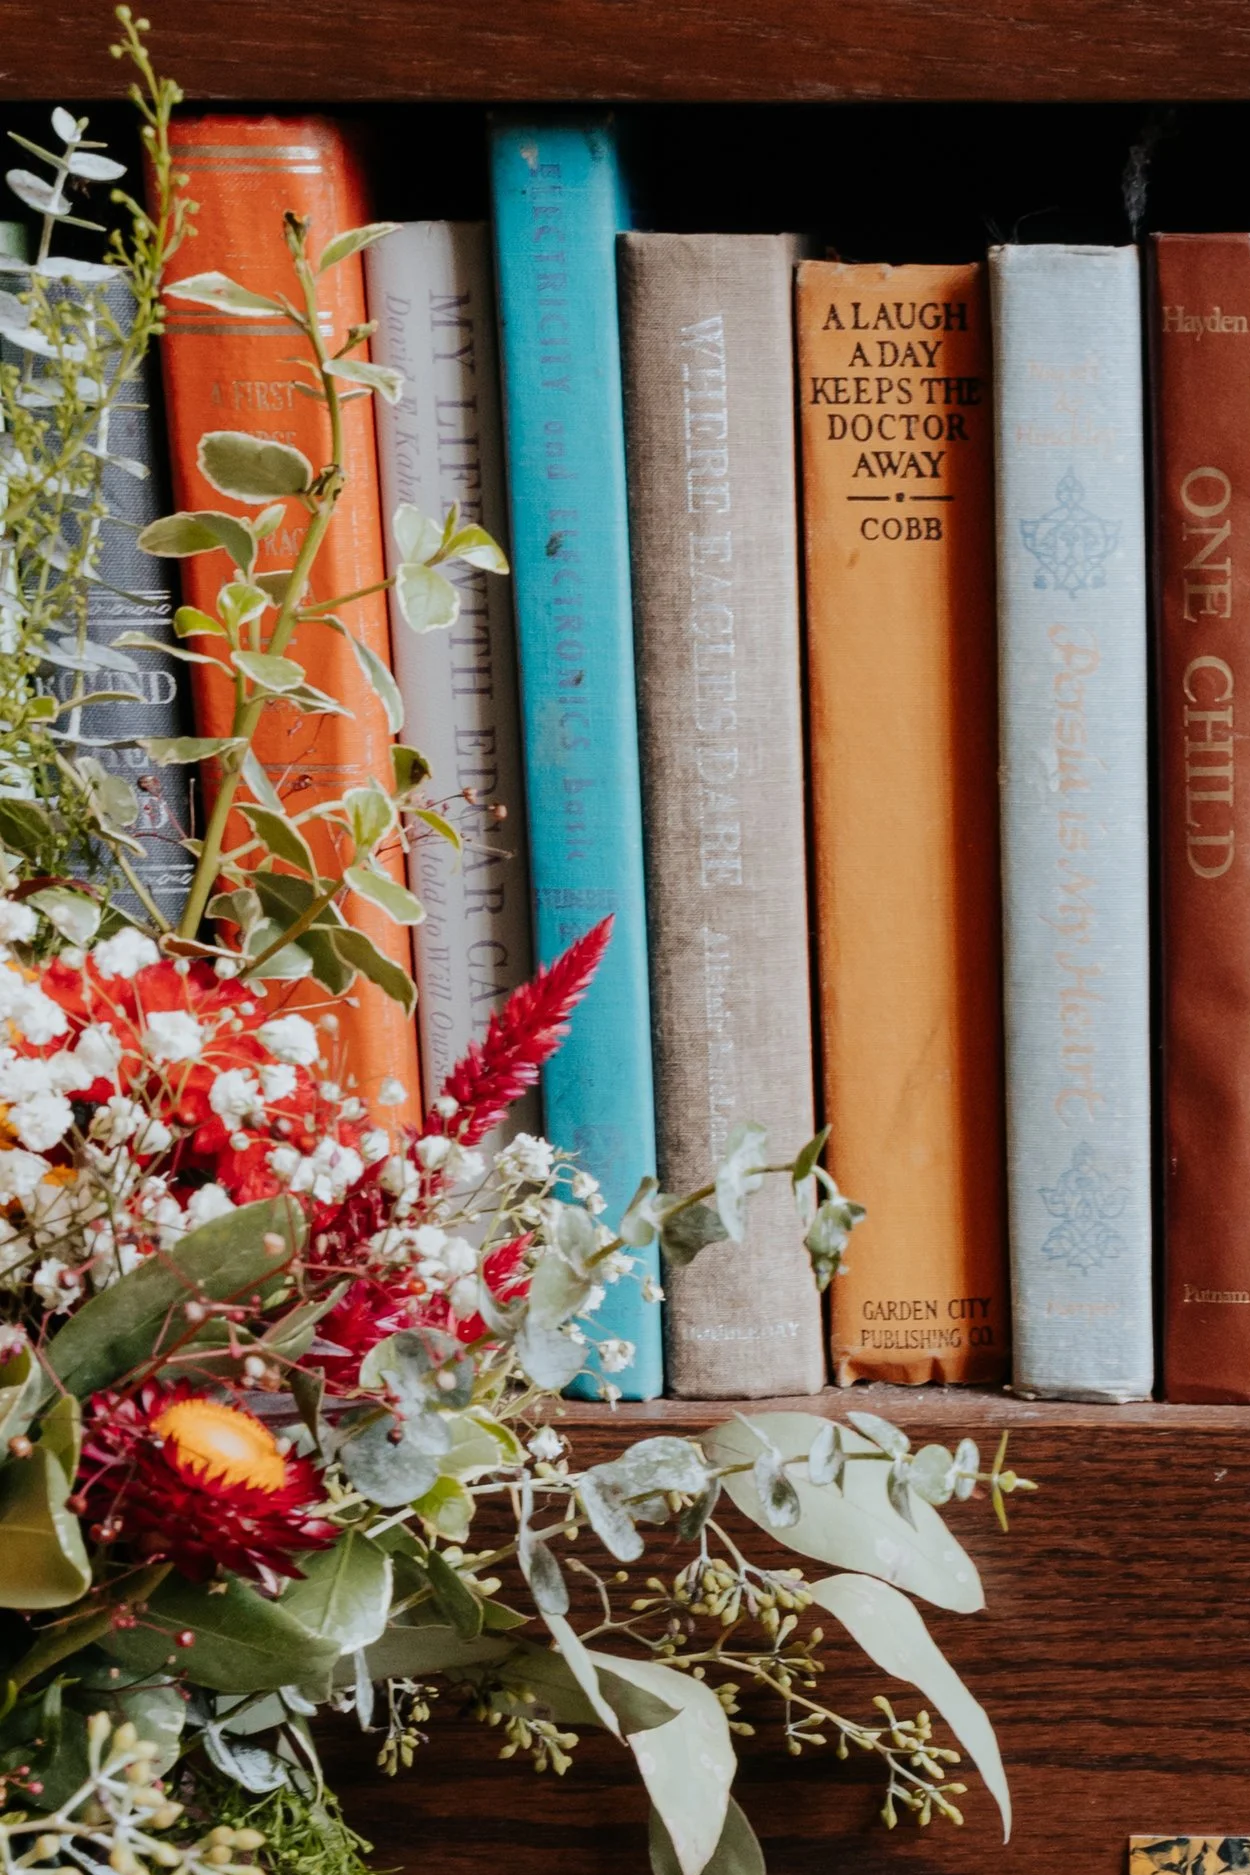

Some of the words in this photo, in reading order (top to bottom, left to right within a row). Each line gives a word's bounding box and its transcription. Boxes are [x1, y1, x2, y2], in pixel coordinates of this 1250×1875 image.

[822, 302, 845, 331] A
[851, 302, 968, 331] LAUGH
[1163, 305, 1248, 341] Hayden
[429, 289, 476, 374] MY
[848, 341, 871, 368] A
[878, 341, 943, 368] DAY
[233, 380, 296, 411] FIRST
[811, 377, 912, 405] KEEPS
[920, 377, 981, 405] THE
[828, 414, 968, 441] DOCTOR
[435, 396, 484, 528] LIFE
[852, 451, 946, 478] AWAY
[860, 517, 943, 541] COBB
[1180, 466, 1233, 623] ONE
[1183, 655, 1235, 879] CHILD
[1184, 1284, 1250, 1303] Putnam
[863, 1300, 937, 1321] GARDEN
[948, 1298, 992, 1320] CITY
[861, 1329, 961, 1350] PUBLISHING
